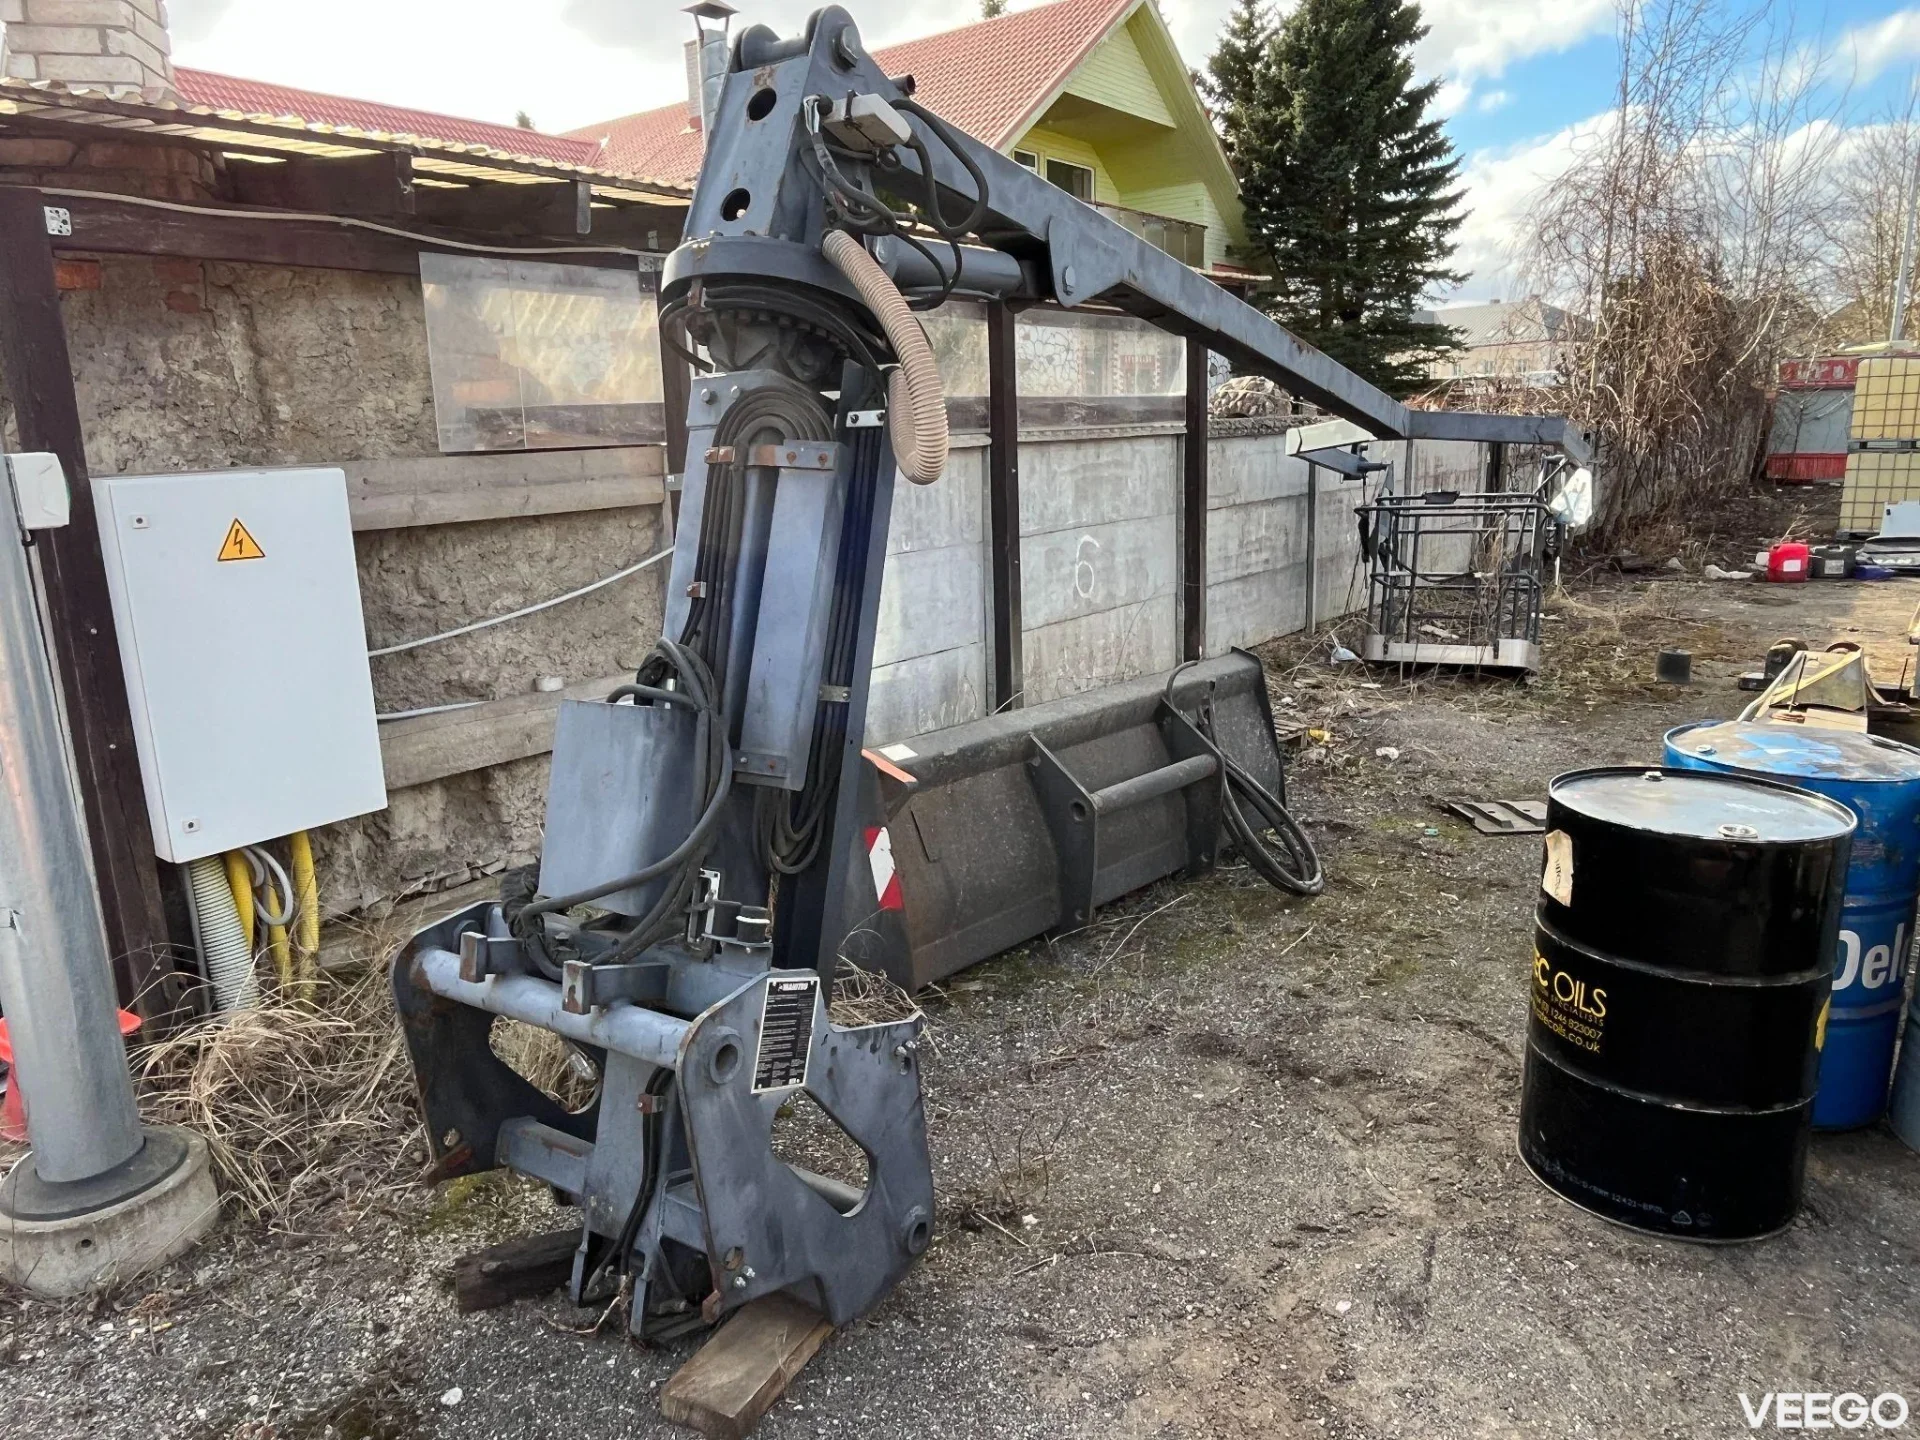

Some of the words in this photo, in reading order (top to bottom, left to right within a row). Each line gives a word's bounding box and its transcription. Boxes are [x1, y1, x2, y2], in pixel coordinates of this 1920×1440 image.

[1074, 534, 1101, 599] 6
[1832, 922, 1909, 991] Del
[1554, 971, 1607, 1018] OILS
[1568, 1018, 1603, 1041] 823007
